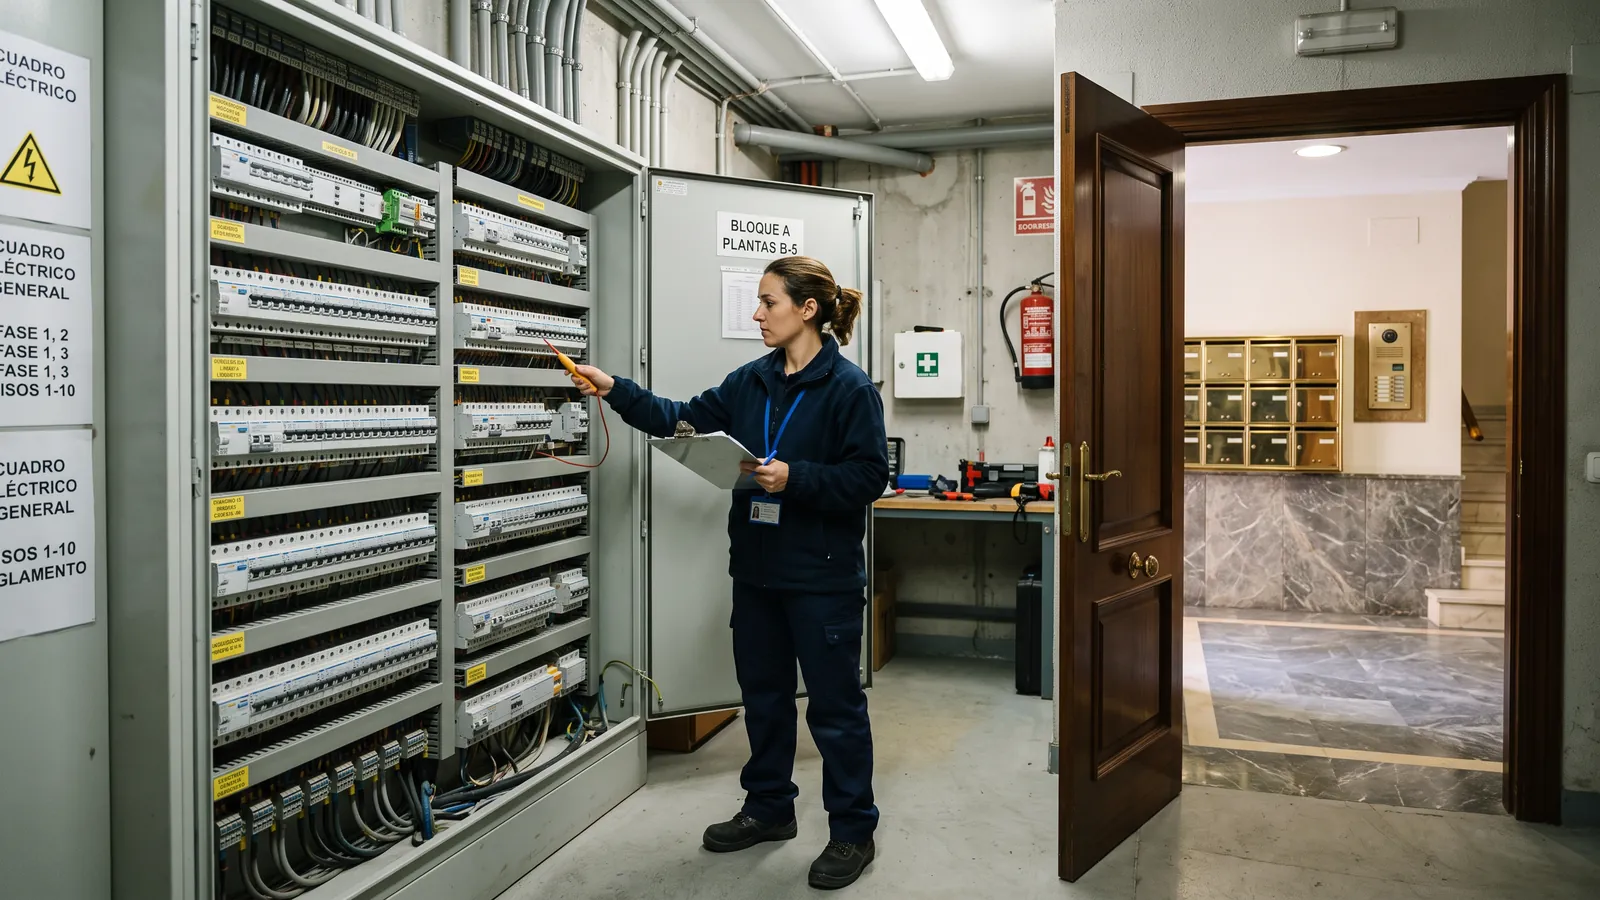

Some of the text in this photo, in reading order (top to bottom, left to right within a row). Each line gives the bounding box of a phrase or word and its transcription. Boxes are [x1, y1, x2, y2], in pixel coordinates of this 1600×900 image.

[731, 219, 791, 237] BLOQUE A
[723, 237, 798, 256] PLANTAS B-5
[0, 281, 70, 300] ENERAL
[43, 327, 56, 343] 1,
[60, 328, 69, 341] 2
[43, 346, 56, 362] 1,
[60, 347, 69, 360] 3
[43, 365, 56, 381] 1,
[60, 366, 69, 379] 3
[44, 383, 76, 397] 1-10
[0, 500, 75, 521] GENERAL
[43, 541, 76, 559] 1-10
